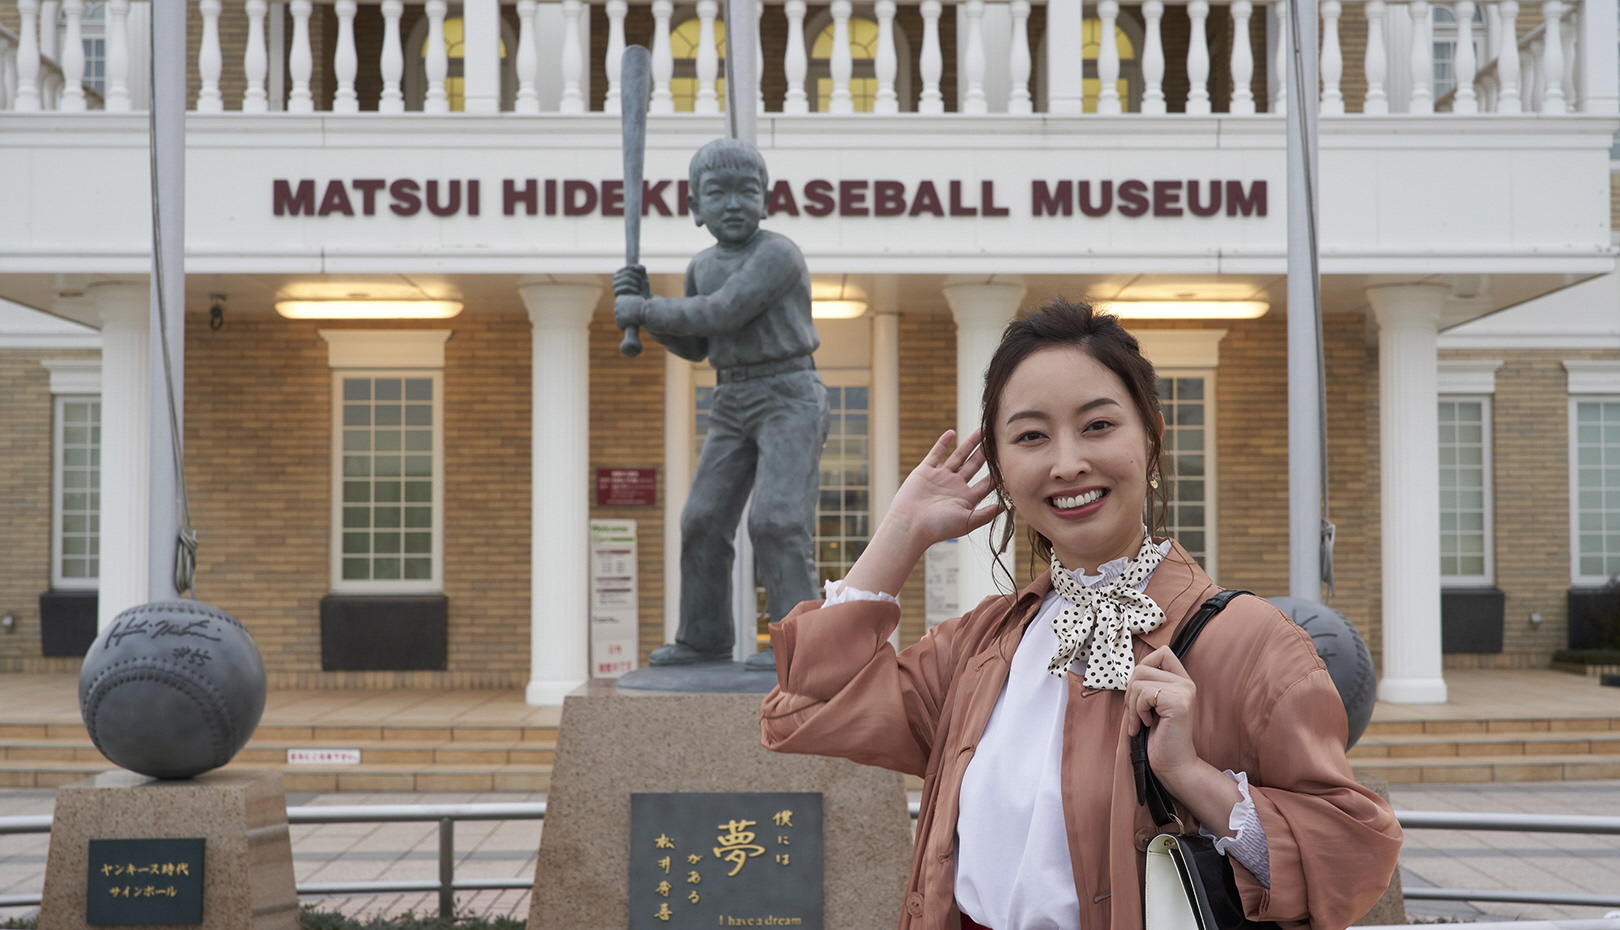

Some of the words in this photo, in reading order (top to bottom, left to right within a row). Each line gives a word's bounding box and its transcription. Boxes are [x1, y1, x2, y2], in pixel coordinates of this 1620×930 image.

[273, 179, 480, 217] MATSUI
[502, 179, 690, 217] HIDEKI
[767, 179, 1010, 217] ASEBALL
[1031, 179, 1269, 217] MUSEUM
[712, 819, 766, 877] 夢
[772, 809, 794, 866] 僕には
[100, 862, 190, 877] ヤンキース時代
[653, 832, 676, 921] 松井秀喜
[686, 853, 704, 904] がある
[718, 915, 724, 926] I
[727, 916, 755, 926] have
[756, 917, 763, 926] a
[764, 915, 802, 926] dream
